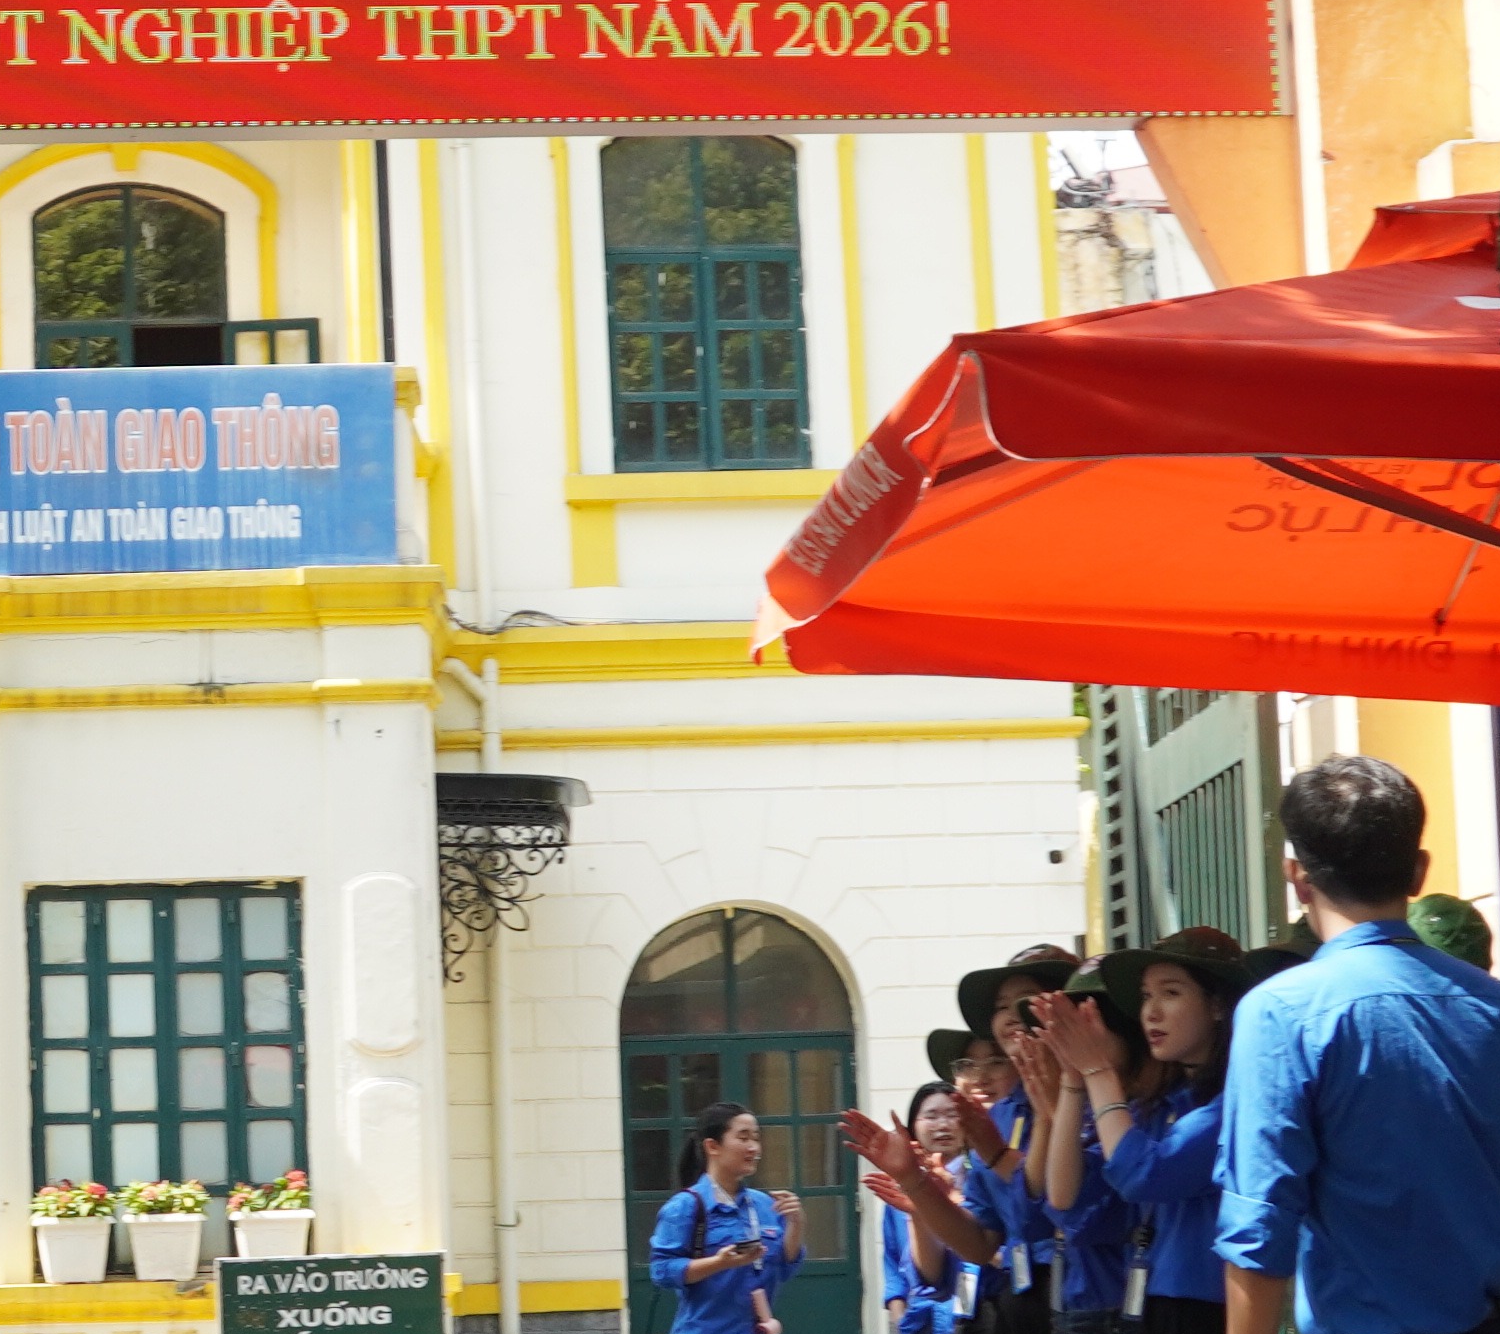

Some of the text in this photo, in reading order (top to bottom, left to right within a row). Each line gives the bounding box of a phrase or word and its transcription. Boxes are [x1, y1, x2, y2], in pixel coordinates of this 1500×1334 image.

[366, 4, 564, 63] THPT
[773, 0, 952, 59] 2026!
[4, 397, 109, 475] TOÀN
[114, 405, 207, 473] GIAO
[211, 392, 341, 471] THÔNG
[12, 503, 68, 551] LUẬT
[70, 507, 105, 542] AN
[106, 500, 168, 542] TOÀN
[170, 506, 225, 540] GIAO
[226, 498, 302, 539] THÔNG
[236, 1274, 271, 1296] RA
[271, 1265, 329, 1295] VÀO
[276, 1300, 394, 1329] XUỐNG
